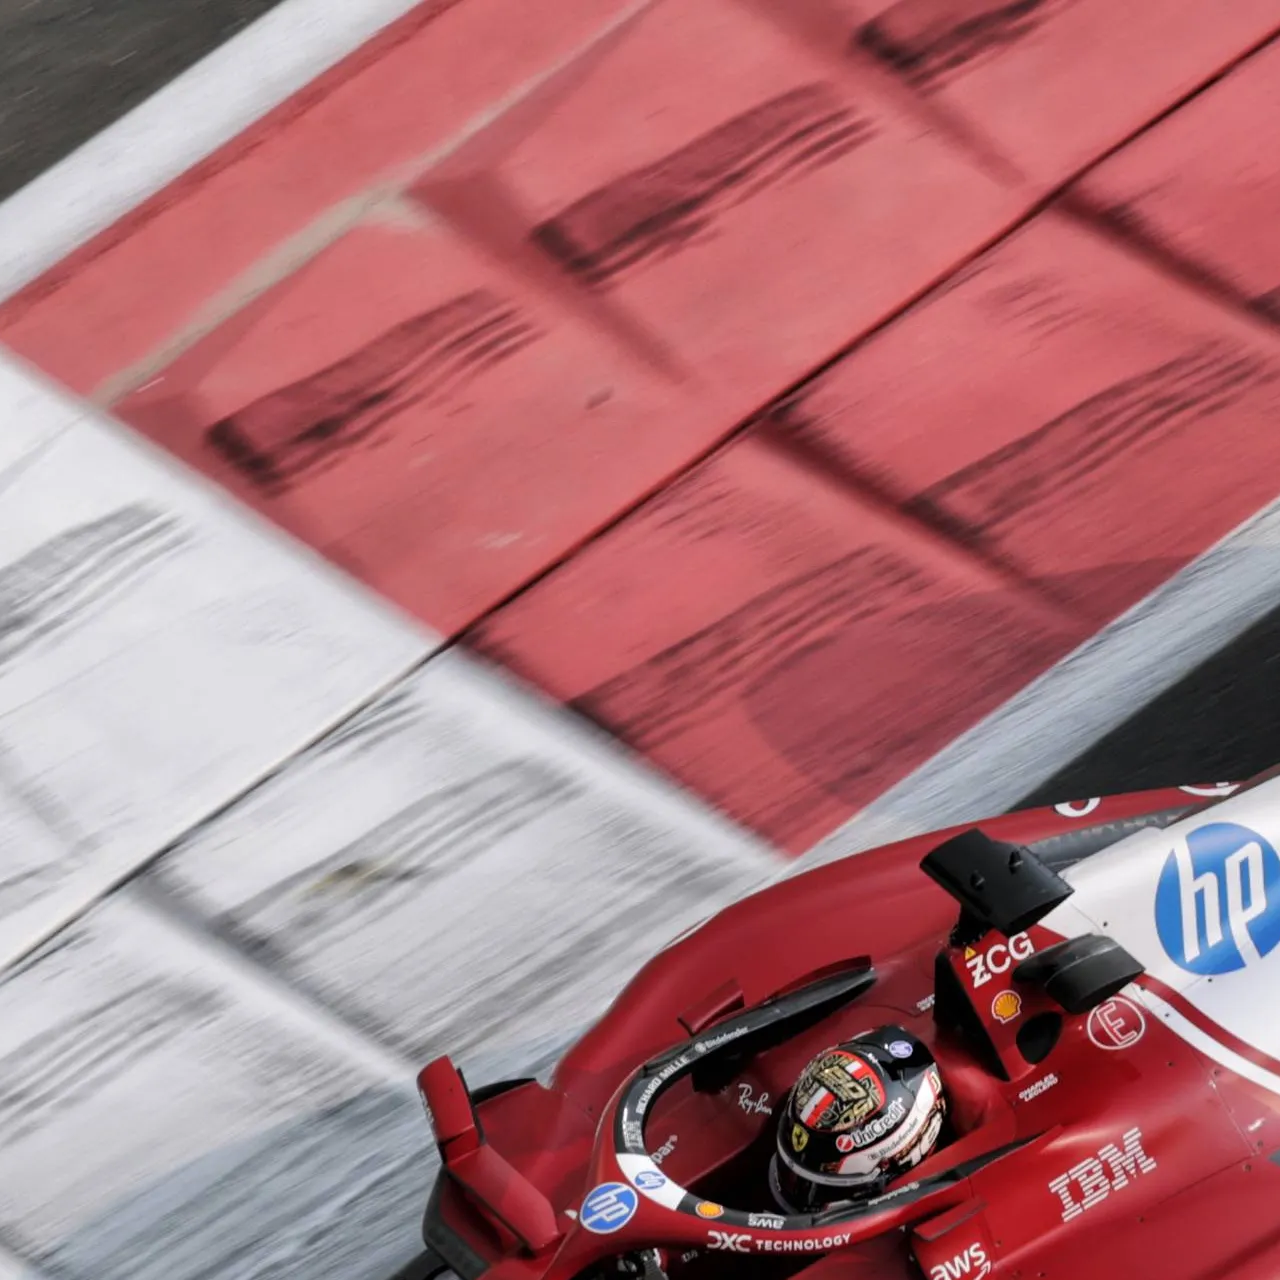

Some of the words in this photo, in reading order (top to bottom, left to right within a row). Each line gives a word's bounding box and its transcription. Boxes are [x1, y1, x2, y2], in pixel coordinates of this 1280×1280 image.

[1166, 834, 1273, 973] hp
[851, 1097, 906, 1148] UniCredit
[1049, 1127, 1157, 1223] IBM
[582, 1184, 636, 1232] hp
[707, 1231, 751, 1252] DXC
[756, 1234, 851, 1251] TECHNOLOGY
